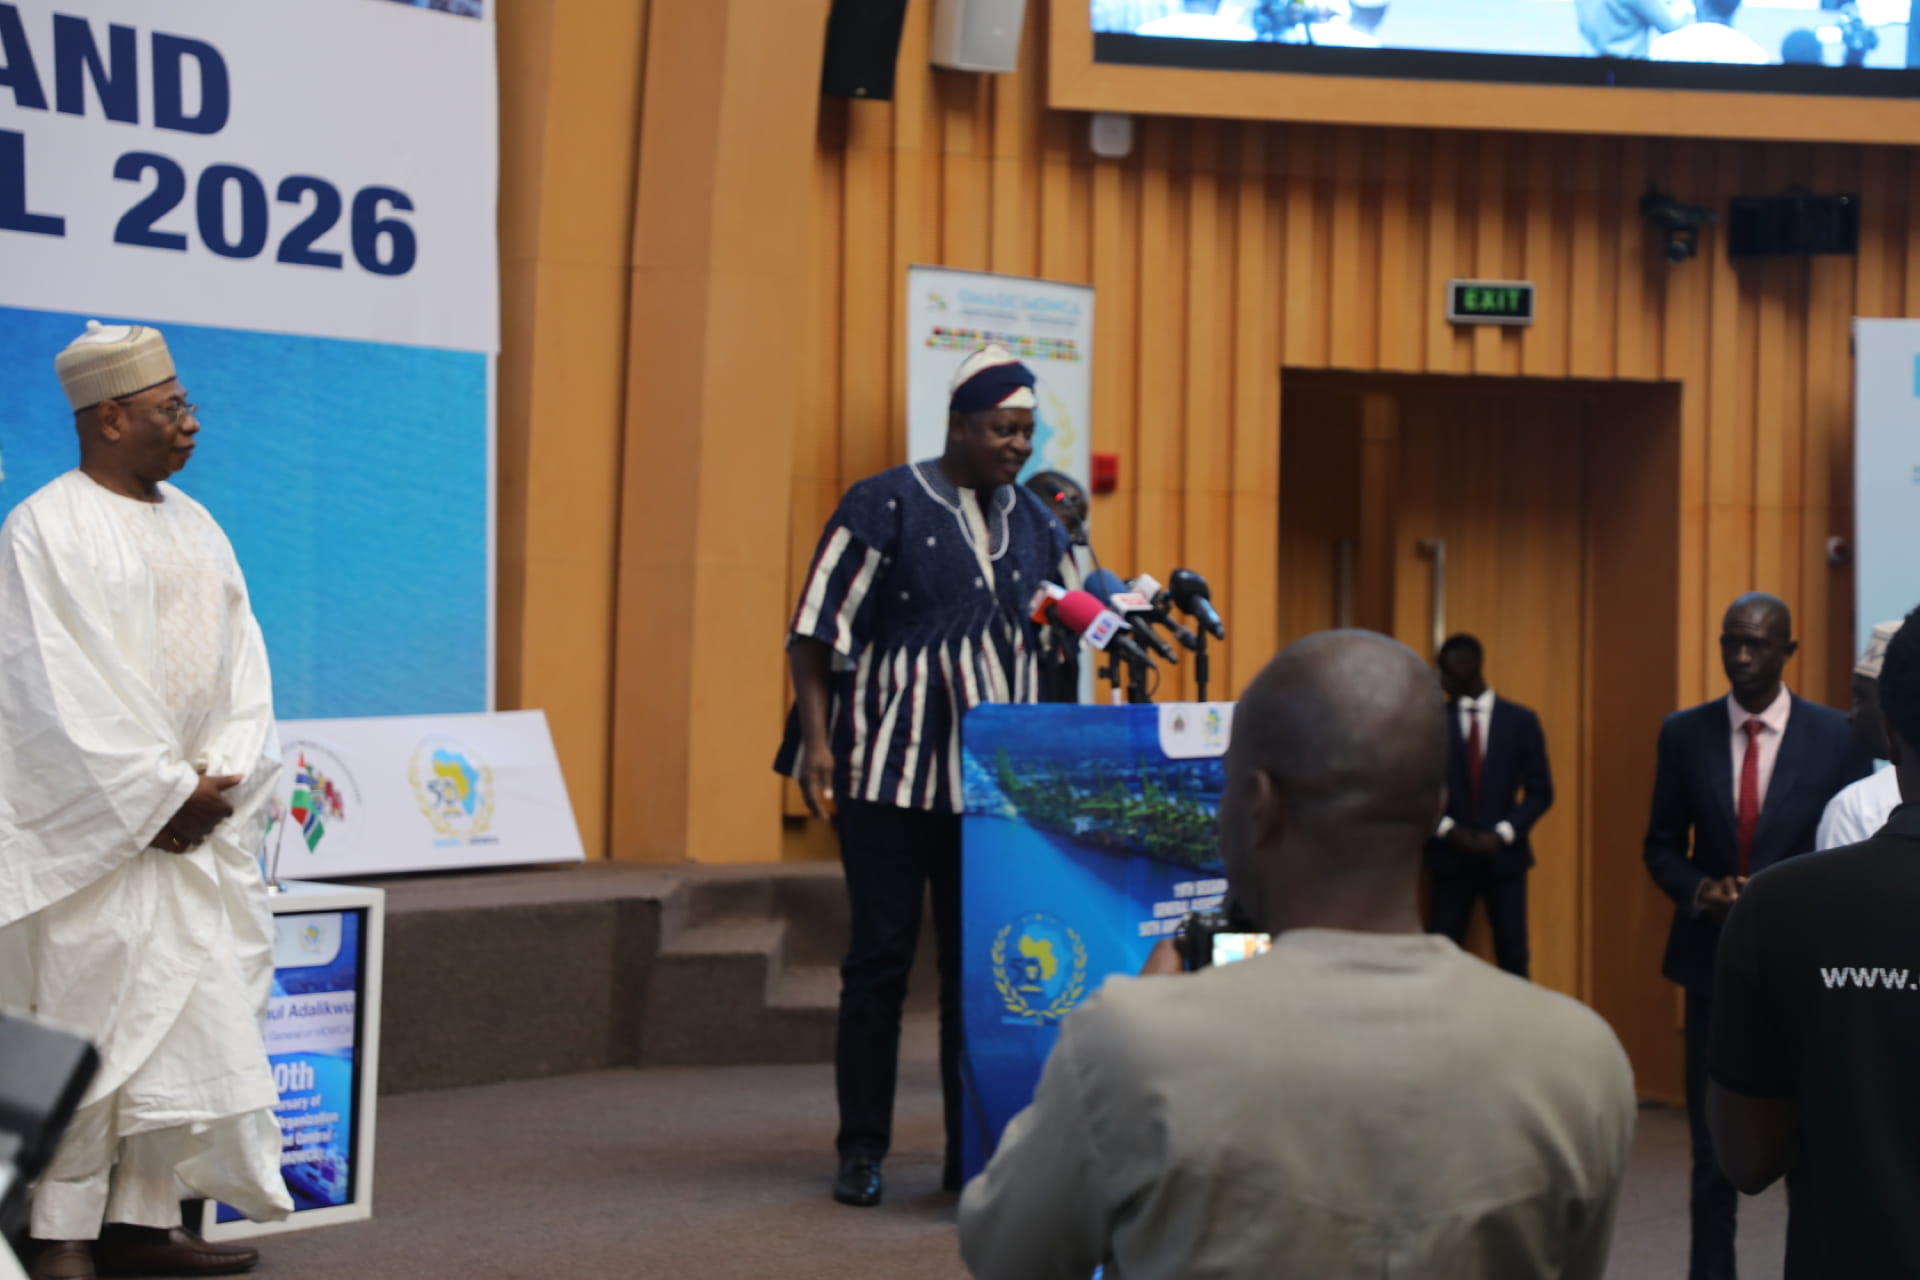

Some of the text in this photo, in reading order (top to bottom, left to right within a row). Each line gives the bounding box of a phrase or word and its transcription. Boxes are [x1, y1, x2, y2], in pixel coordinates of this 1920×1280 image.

[113, 150, 417, 276] 2026
[1463, 286, 1520, 312] EXIT
[1820, 967, 1920, 990] www.
